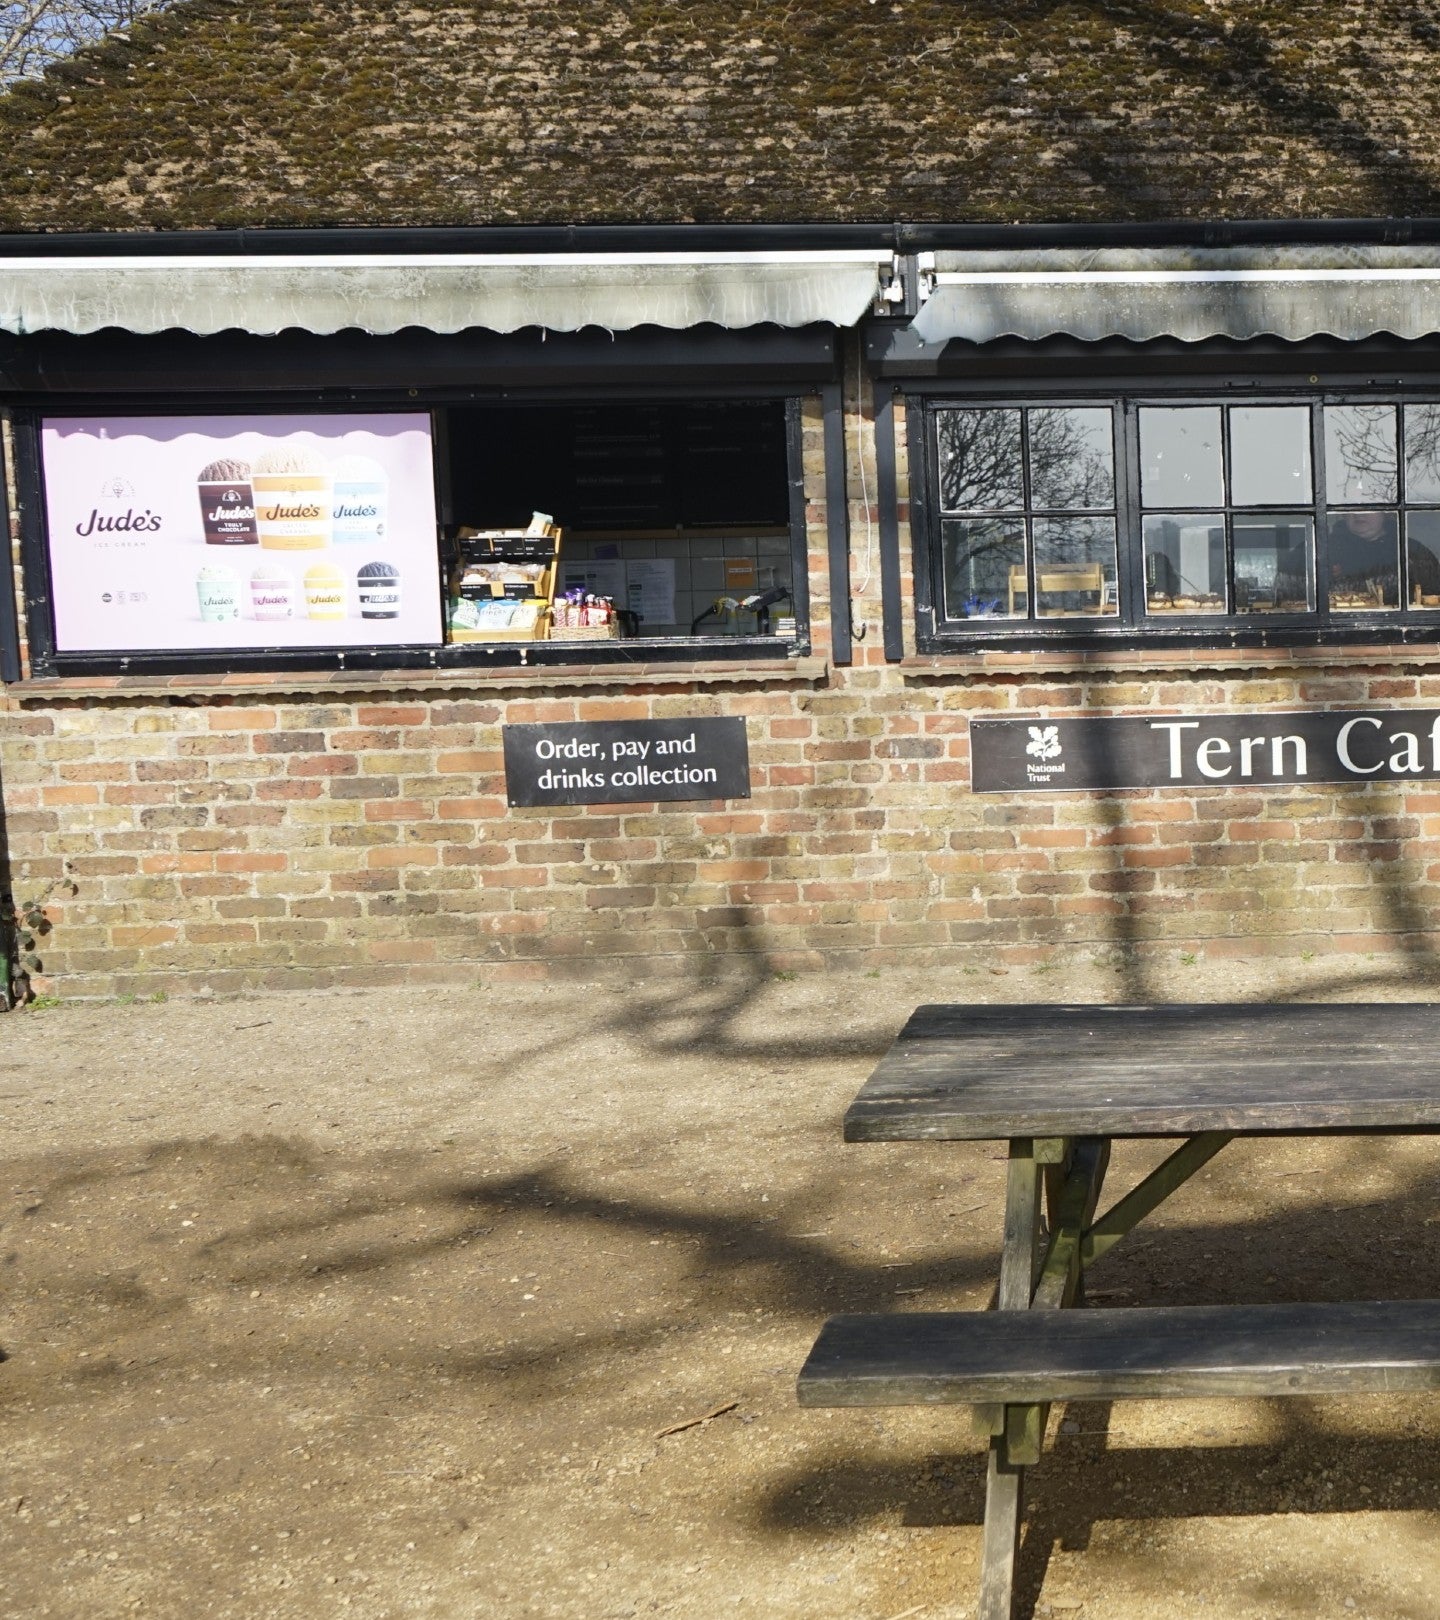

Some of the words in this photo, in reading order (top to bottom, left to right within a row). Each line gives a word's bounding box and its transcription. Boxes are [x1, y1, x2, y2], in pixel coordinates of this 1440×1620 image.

[209, 505, 255, 521] Jude's
[266, 503, 321, 521] Jude's
[333, 504, 377, 519] Jude's
[76, 508, 162, 537] Jude's
[204, 597, 233, 606] Jude's
[257, 595, 288, 605] Jude's
[311, 595, 341, 604] Jude's
[536, 737, 606, 760] Order,
[612, 740, 650, 761] pay
[655, 733, 696, 755] and
[1150, 721, 1308, 779] Tern
[1027, 763, 1065, 773] National
[538, 767, 605, 789] drinks
[611, 764, 717, 787] collection
[1027, 773, 1051, 782] Trust
